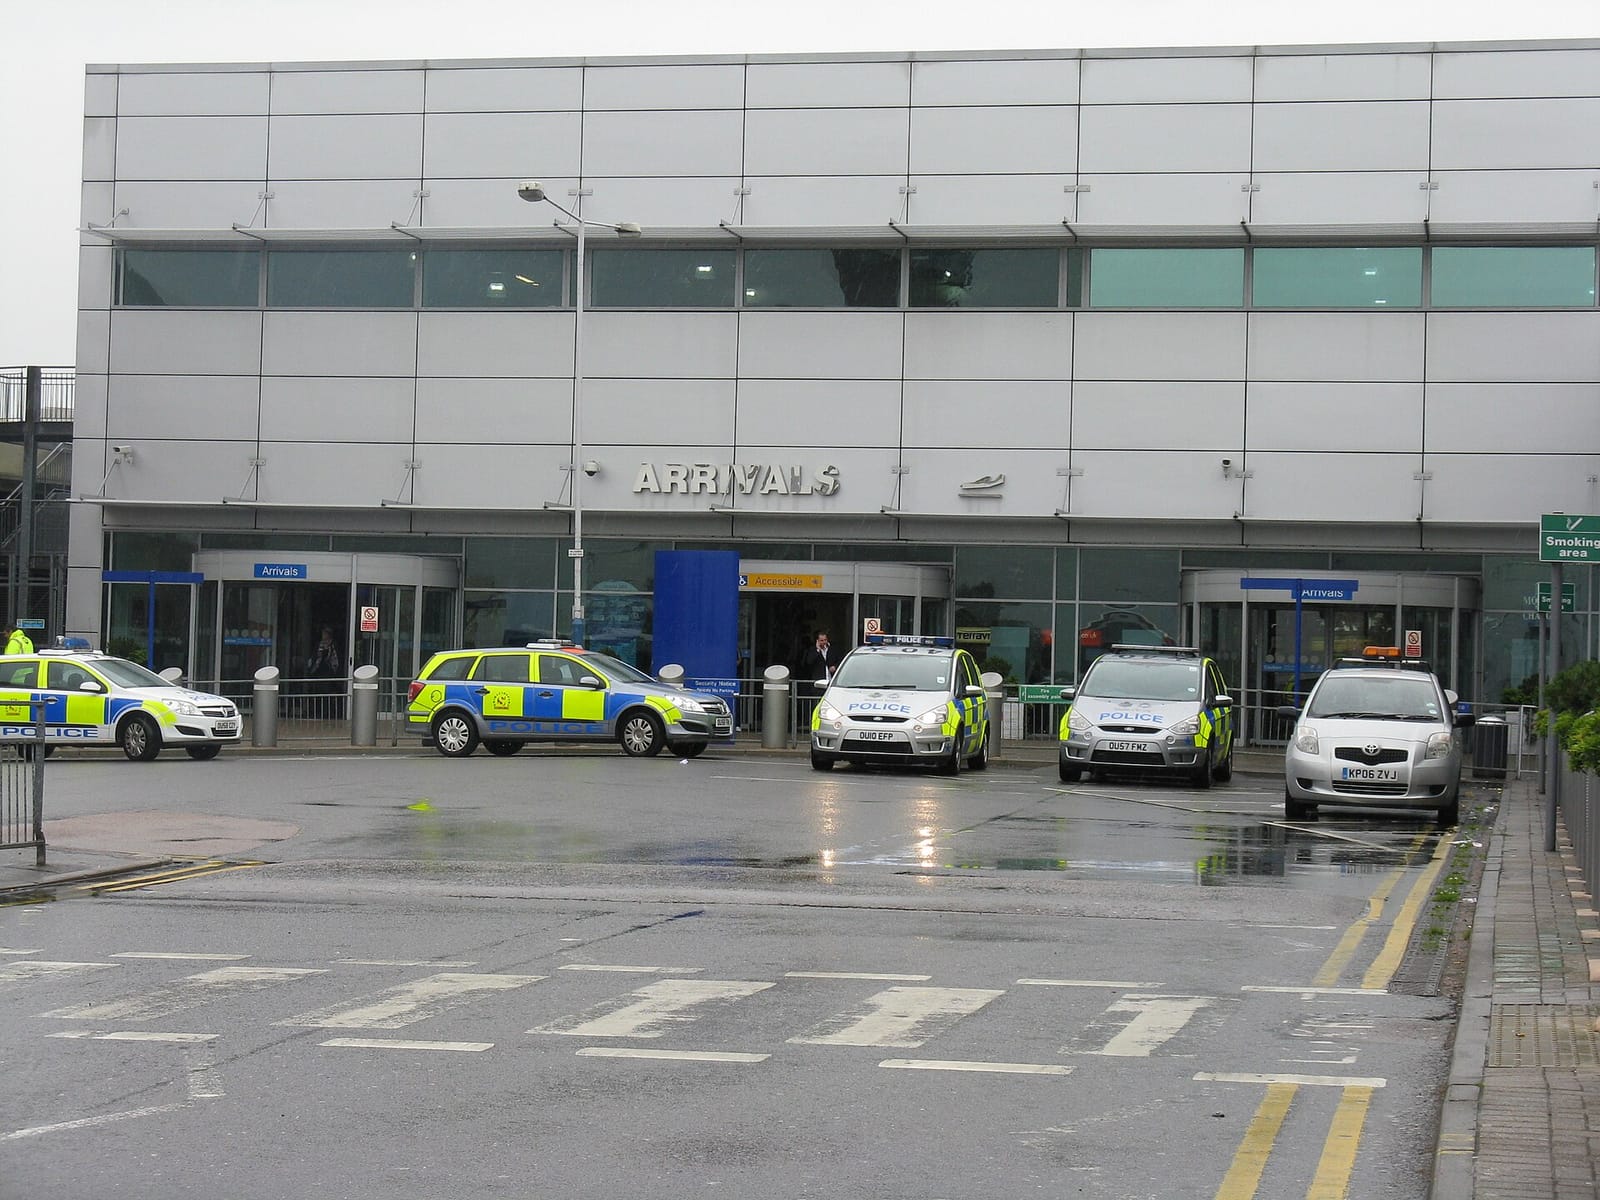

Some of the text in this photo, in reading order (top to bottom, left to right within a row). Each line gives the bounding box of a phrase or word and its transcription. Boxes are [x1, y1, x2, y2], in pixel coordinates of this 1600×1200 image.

[633, 463, 841, 496] ARRIVALS
[1546, 536, 1600, 549] Smoking
[262, 566, 298, 576] Arrivals
[754, 576, 803, 585] Accessible
[896, 636, 922, 644] POLICE
[849, 703, 912, 714] POLICE
[1099, 712, 1164, 724] POLICE
[489, 722, 605, 733] POLICE
[859, 731, 893, 740] OU10 EFP
[1108, 742, 1148, 751] OU57 FMZ
[1348, 769, 1397, 780] KP06 ZVJ
